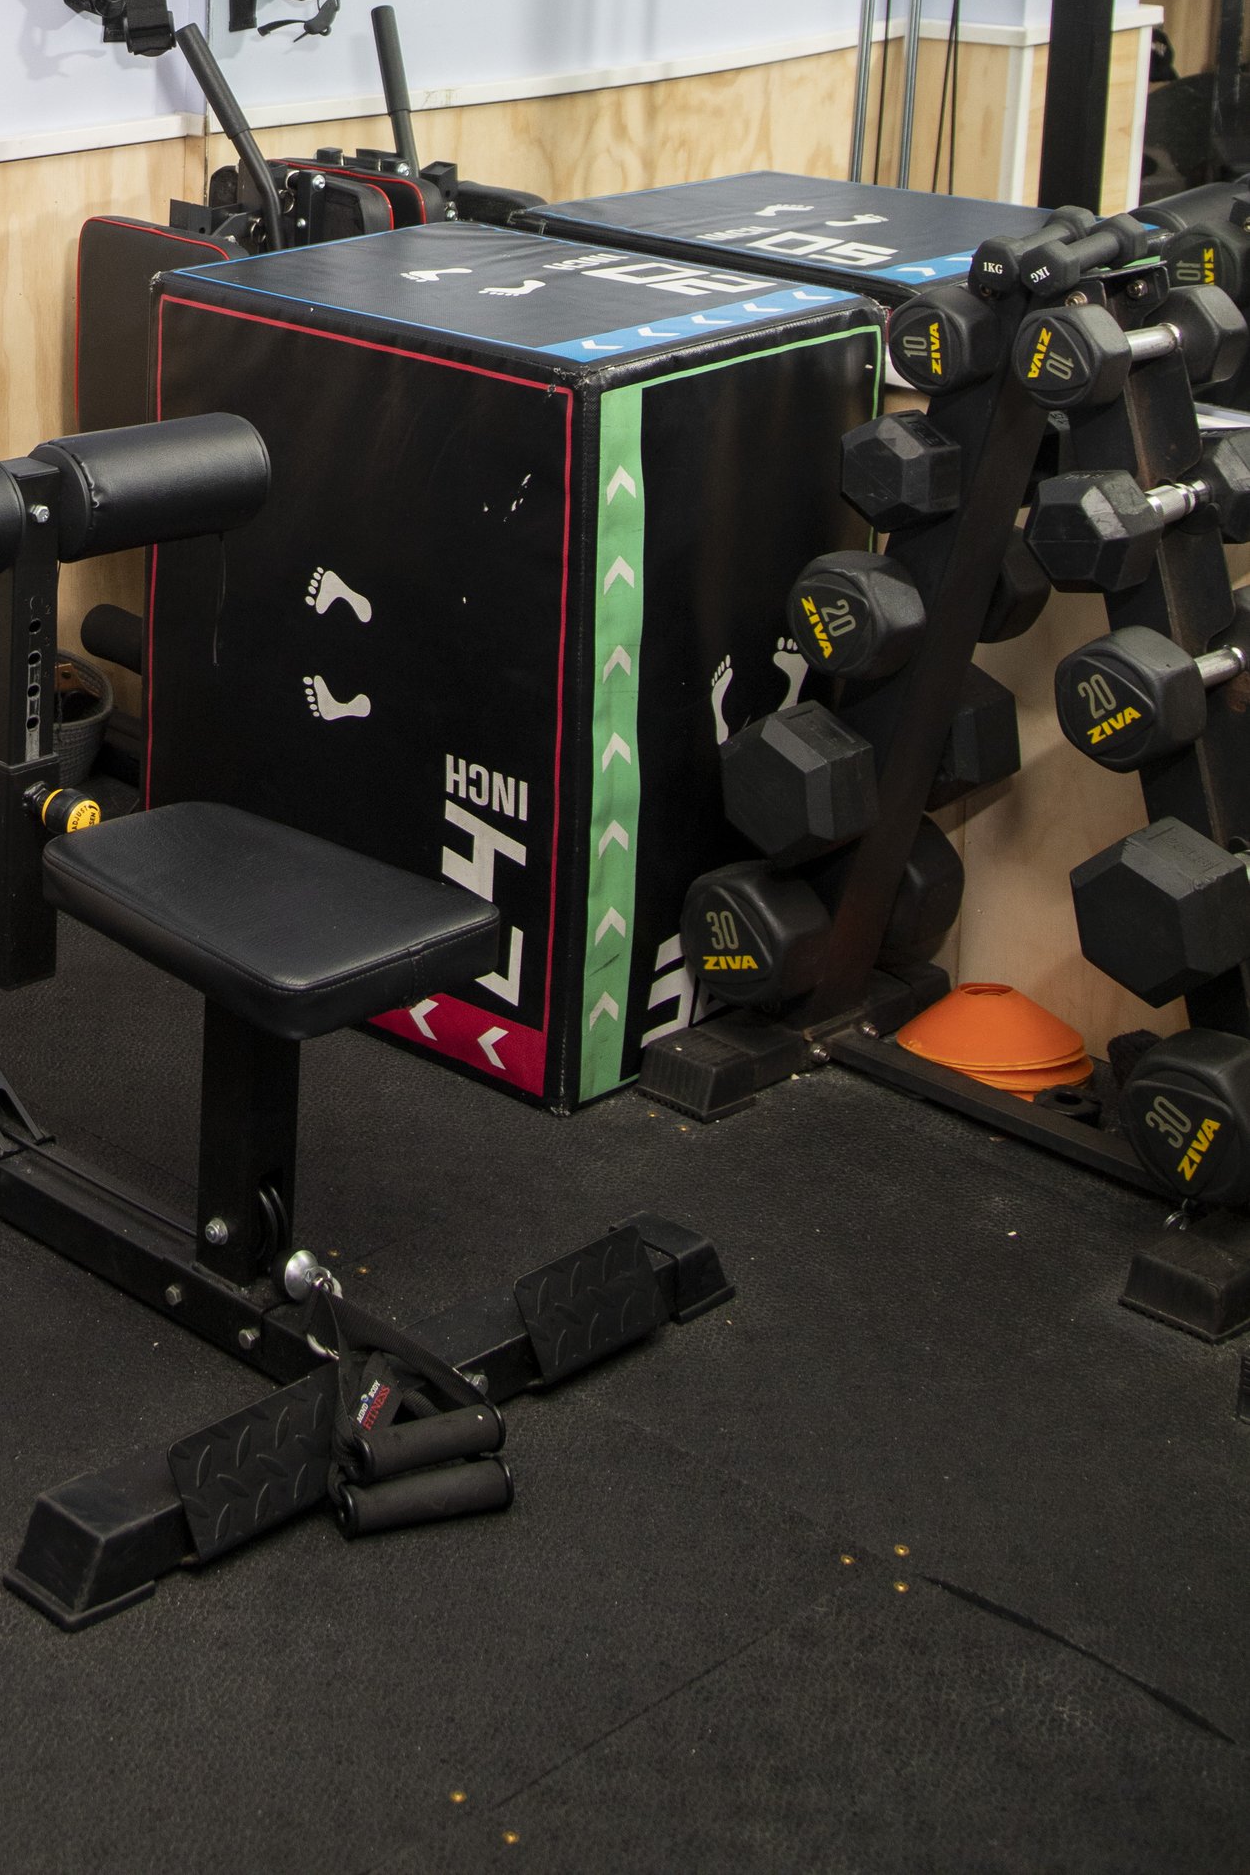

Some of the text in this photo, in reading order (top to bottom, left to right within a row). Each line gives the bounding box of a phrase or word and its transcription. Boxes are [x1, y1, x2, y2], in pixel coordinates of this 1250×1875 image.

[983, 261, 1003, 275] 1KG
[1030, 266, 1051, 283] 1KG
[903, 335, 928, 358] 10
[929, 322, 942, 375] ZIVA
[1027, 327, 1052, 378] ZIVA
[1046, 351, 1075, 381] 10
[801, 595, 833, 659] ZIVA
[821, 598, 856, 637] 20
[1077, 673, 1117, 719] 20
[1086, 706, 1142, 745] ZIVA
[445, 753, 528, 822] INCH
[706, 910, 739, 950] 30
[702, 954, 759, 971] ZIVA
[1145, 1095, 1192, 1149] 30
[1177, 1118, 1222, 1182] ZIVA
[362, 1384, 392, 1431] FITNESS
